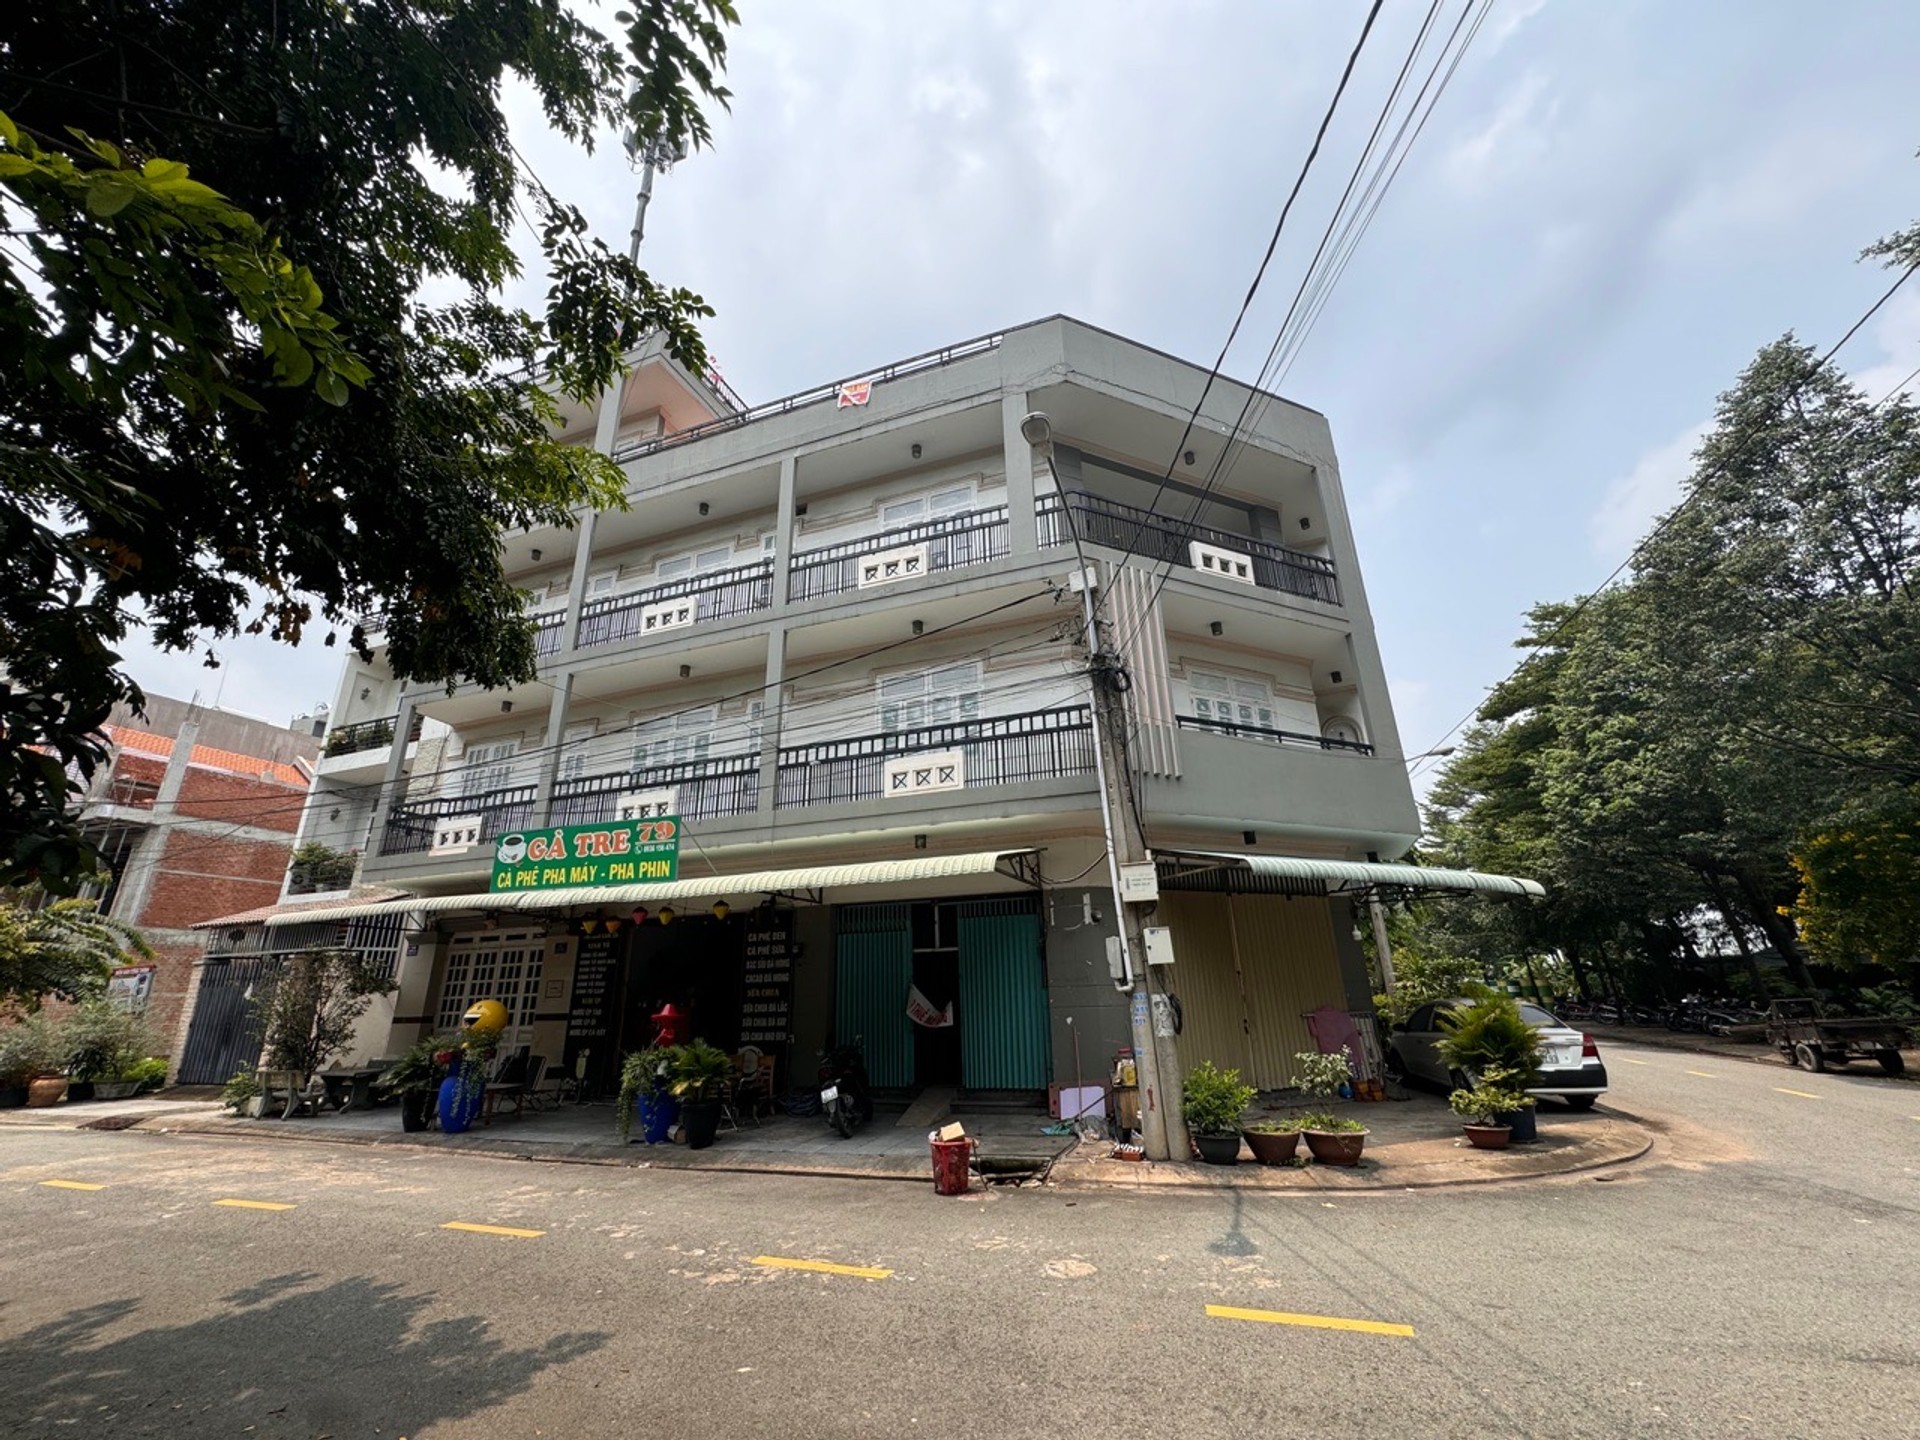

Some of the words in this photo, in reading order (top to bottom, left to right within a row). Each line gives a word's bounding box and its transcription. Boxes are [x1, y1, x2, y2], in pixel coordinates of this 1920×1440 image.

[574, 829, 631, 857] TRE
[636, 821, 676, 842] 79
[497, 868, 512, 888] CÀ
[516, 866, 540, 886] PHÊ
[542, 869, 566, 885] PHA
[569, 862, 598, 883] MÁY
[609, 863, 635, 880] PHA
[639, 860, 671, 879] PHIN
